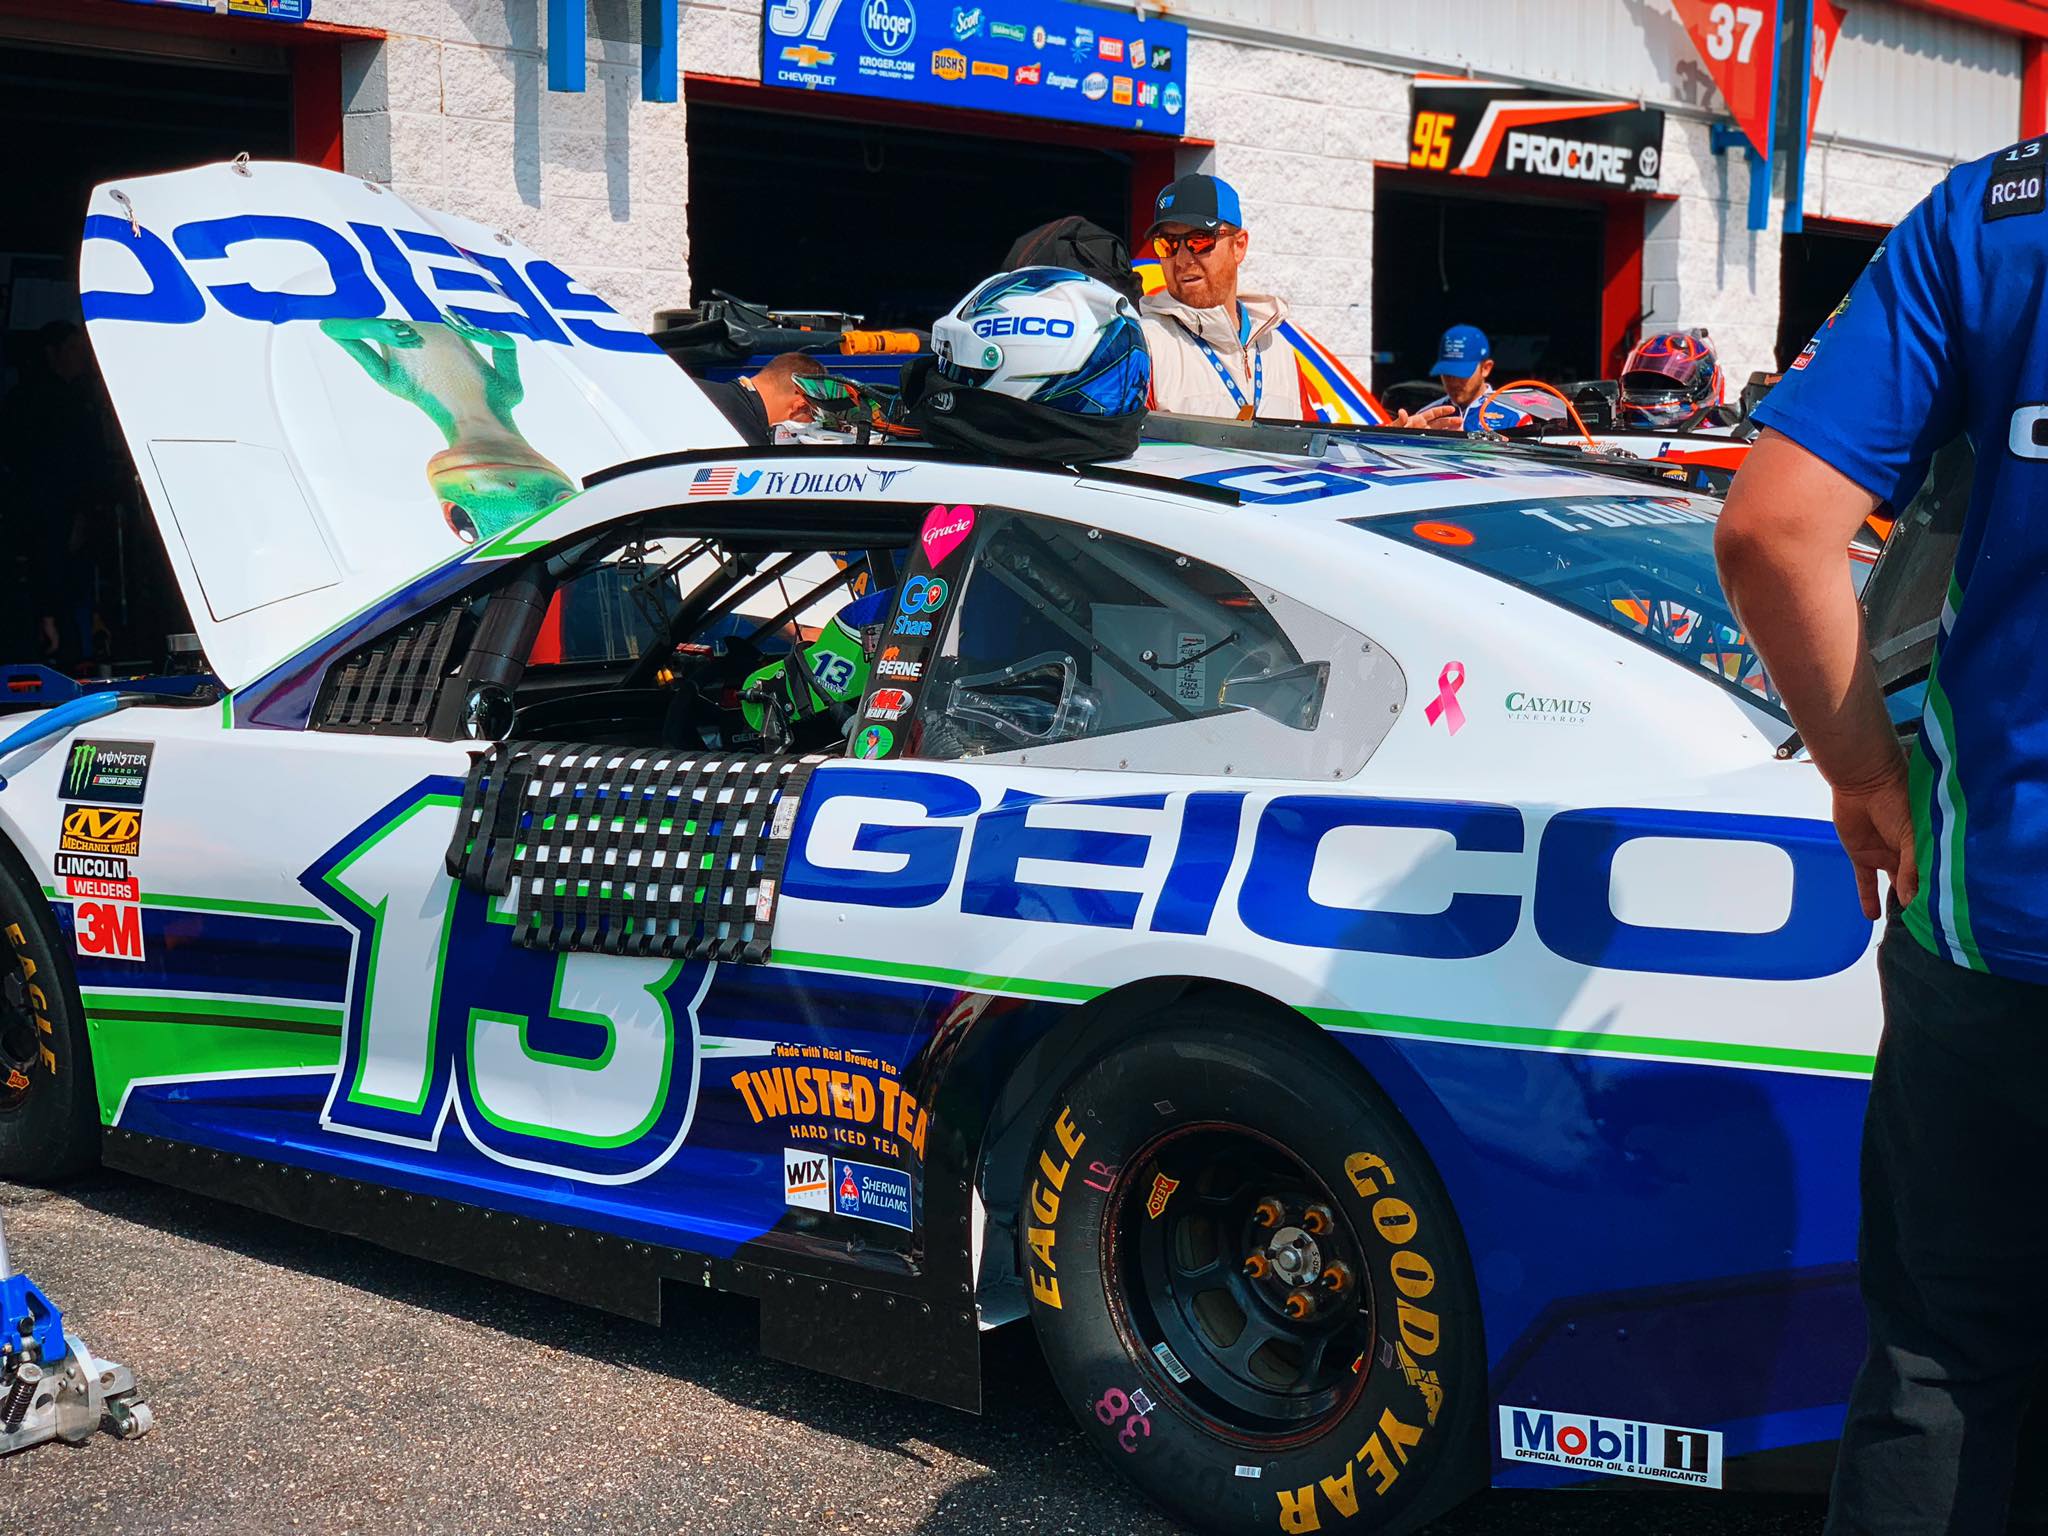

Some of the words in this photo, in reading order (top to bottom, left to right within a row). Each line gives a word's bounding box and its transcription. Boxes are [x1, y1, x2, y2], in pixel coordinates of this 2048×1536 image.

[867, 0, 911, 47] Kroger
[1706, 3, 1763, 64] 37
[778, 70, 837, 86] CHEVROLET
[859, 55, 916, 72] KROGER.COM
[1410, 111, 1456, 171] 95
[2005, 143, 2040, 161] 13
[1506, 132, 1632, 184] PROCORE
[1991, 178, 2040, 205] RC10
[973, 316, 1075, 339] GEICO
[789, 472, 868, 495] DILLON
[923, 518, 971, 546] Gracie
[1519, 508, 1593, 532] T.
[1566, 503, 1718, 528] DILLO
[893, 615, 932, 637] Share
[813, 650, 857, 689] 13
[1508, 713, 1585, 723] VINEYARDS
[96, 751, 147, 766] MONSTER
[62, 835, 110, 853] MECHANIX
[111, 842, 137, 855] WEAR
[58, 856, 124, 879] LINCOLN
[779, 765, 1875, 981] GEICO
[74, 880, 132, 899] WELDERS
[77, 902, 142, 958] 3M
[300, 774, 703, 1180] 13
[5, 922, 56, 1076] EAGLE
[776, 1045, 800, 1057] Made
[801, 1046, 820, 1059] with
[822, 1047, 842, 1061] Real
[844, 1052, 879, 1070] Brewed
[881, 1060, 897, 1075] Tea
[731, 1066, 876, 1124] TWISTED
[879, 1078, 929, 1162] TEA
[790, 1125, 828, 1140] HARD
[834, 1127, 866, 1146] ICED
[873, 1136, 900, 1158] TEA
[787, 1158, 826, 1186] WIX
[861, 1176, 907, 1198] SHERWIN
[861, 1189, 907, 1212] WILLIAMS
[1151, 1180, 1169, 1210] AERO
[1027, 1104, 1086, 1311] EAGLE
[1512, 1410, 1648, 1466] Mobil
[1676, 1434, 1692, 1470] 1
[1515, 1449, 1562, 1463] OFFICIAL
[1564, 1456, 1603, 1470] MOTOR
[1607, 1461, 1624, 1473] OIL
[1626, 1464, 1635, 1473] &
[1638, 1466, 1708, 1483] LUBRICANTS
